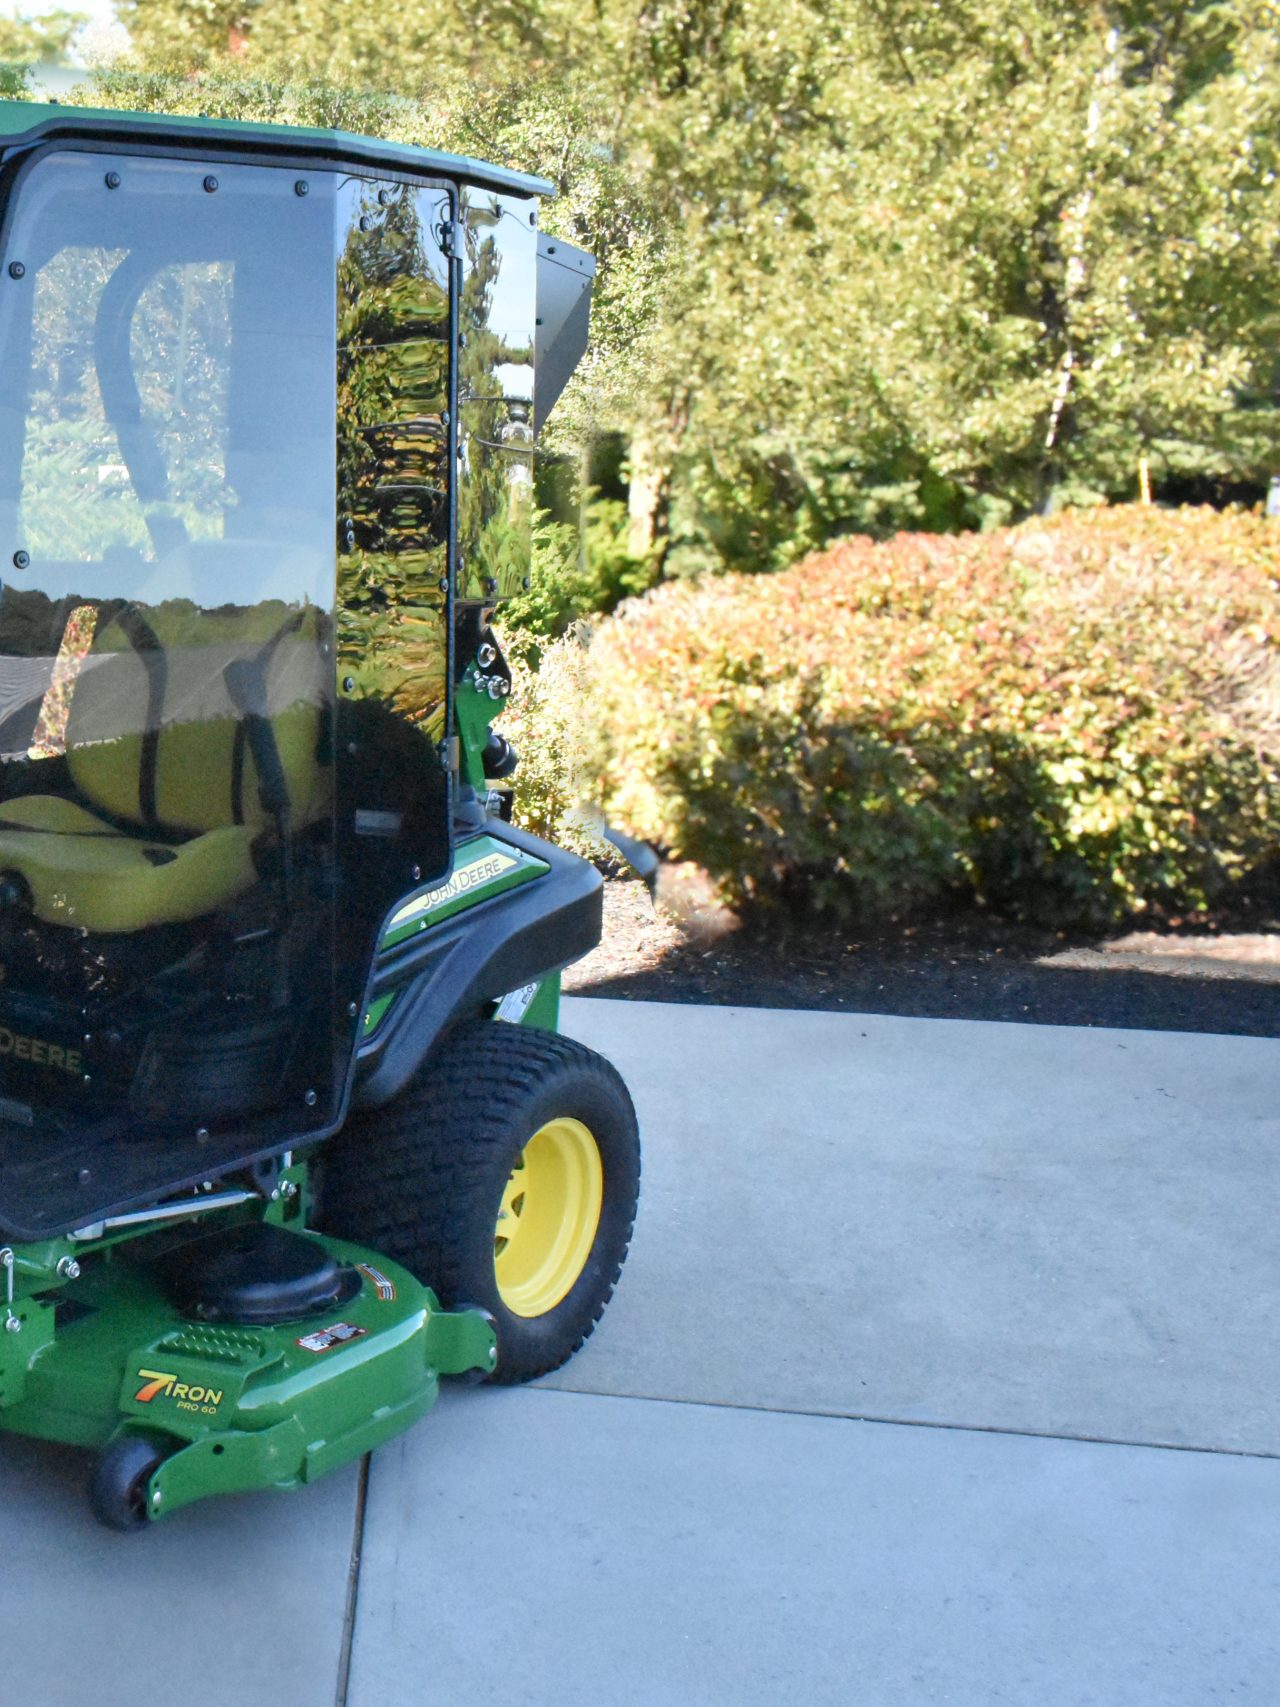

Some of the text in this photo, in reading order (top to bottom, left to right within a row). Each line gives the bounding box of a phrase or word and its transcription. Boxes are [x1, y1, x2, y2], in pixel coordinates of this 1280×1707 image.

[423, 860, 501, 907] JOHN DEERE
[177, 1401, 216, 1414] PRO 60
